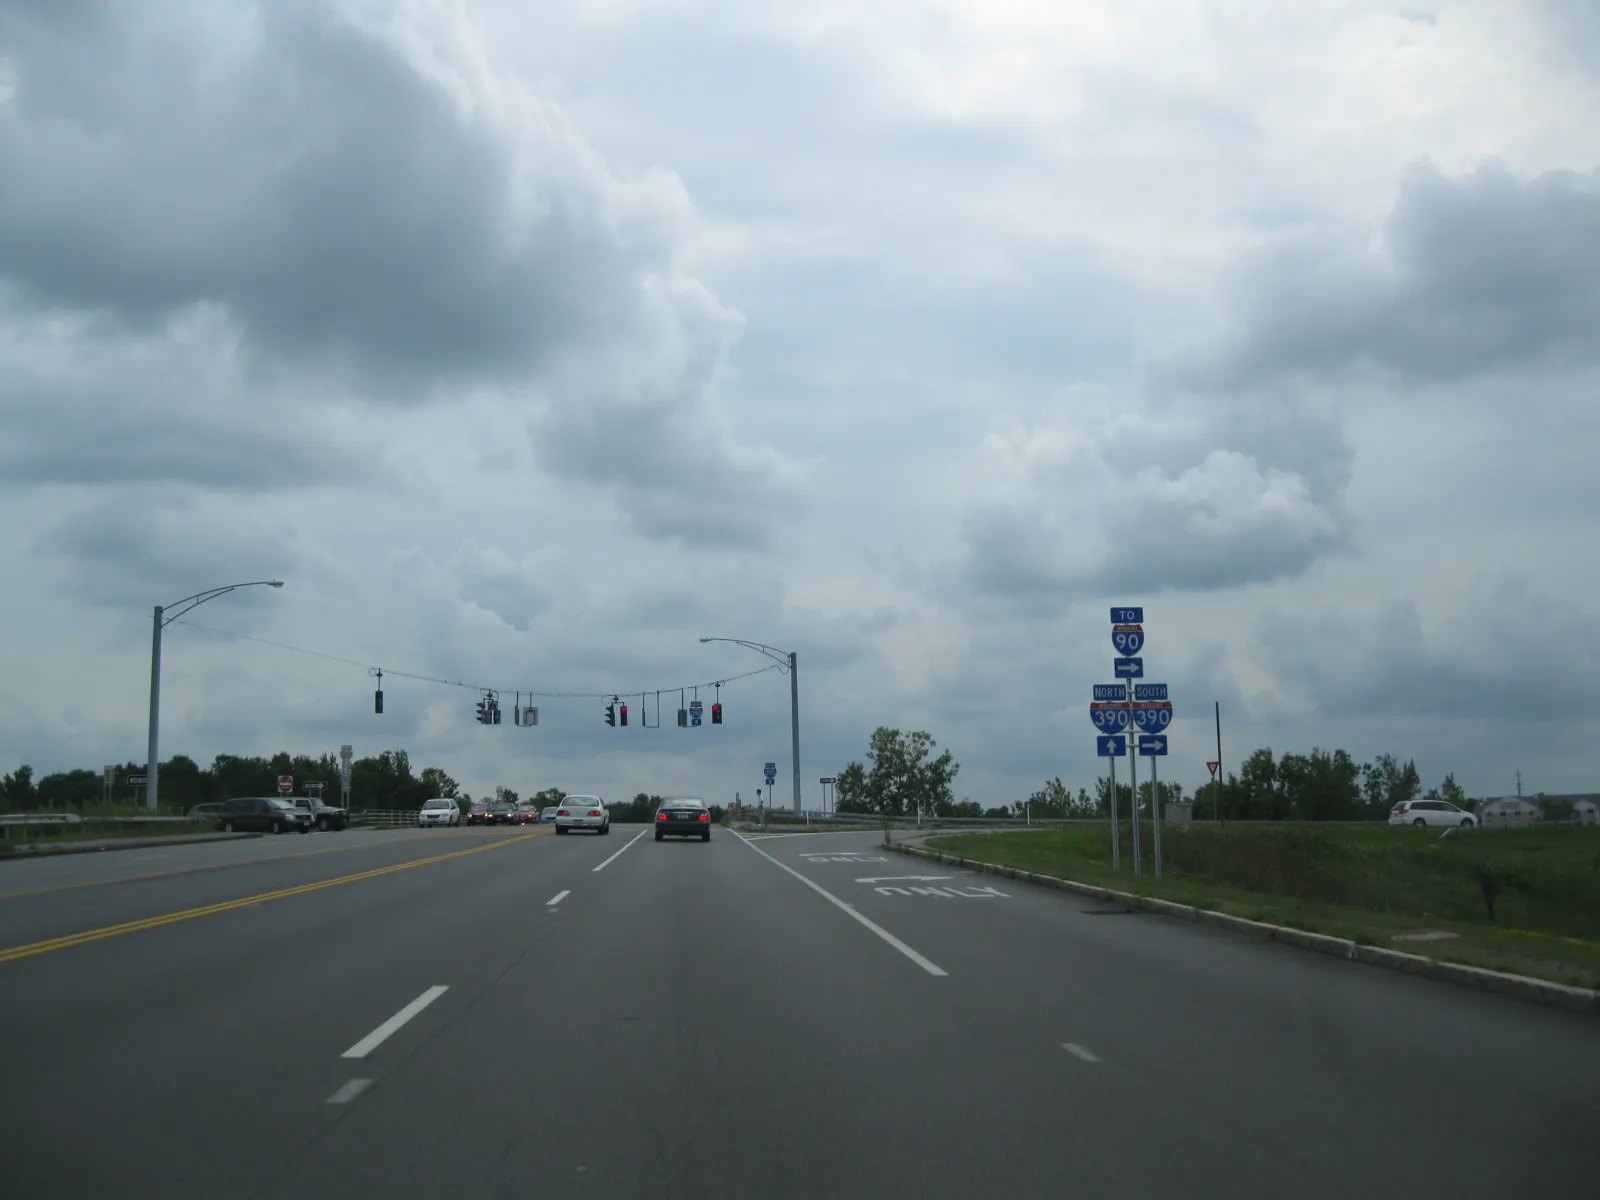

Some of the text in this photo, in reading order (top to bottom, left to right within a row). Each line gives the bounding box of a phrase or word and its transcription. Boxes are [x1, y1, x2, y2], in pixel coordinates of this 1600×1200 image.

[1119, 610, 1135, 621] TO
[1116, 634, 1139, 649] 90
[1095, 687, 1125, 698] NORTH
[1137, 687, 1166, 697] SOUTH
[1095, 710, 1128, 726] 390
[1137, 710, 1169, 726] 390
